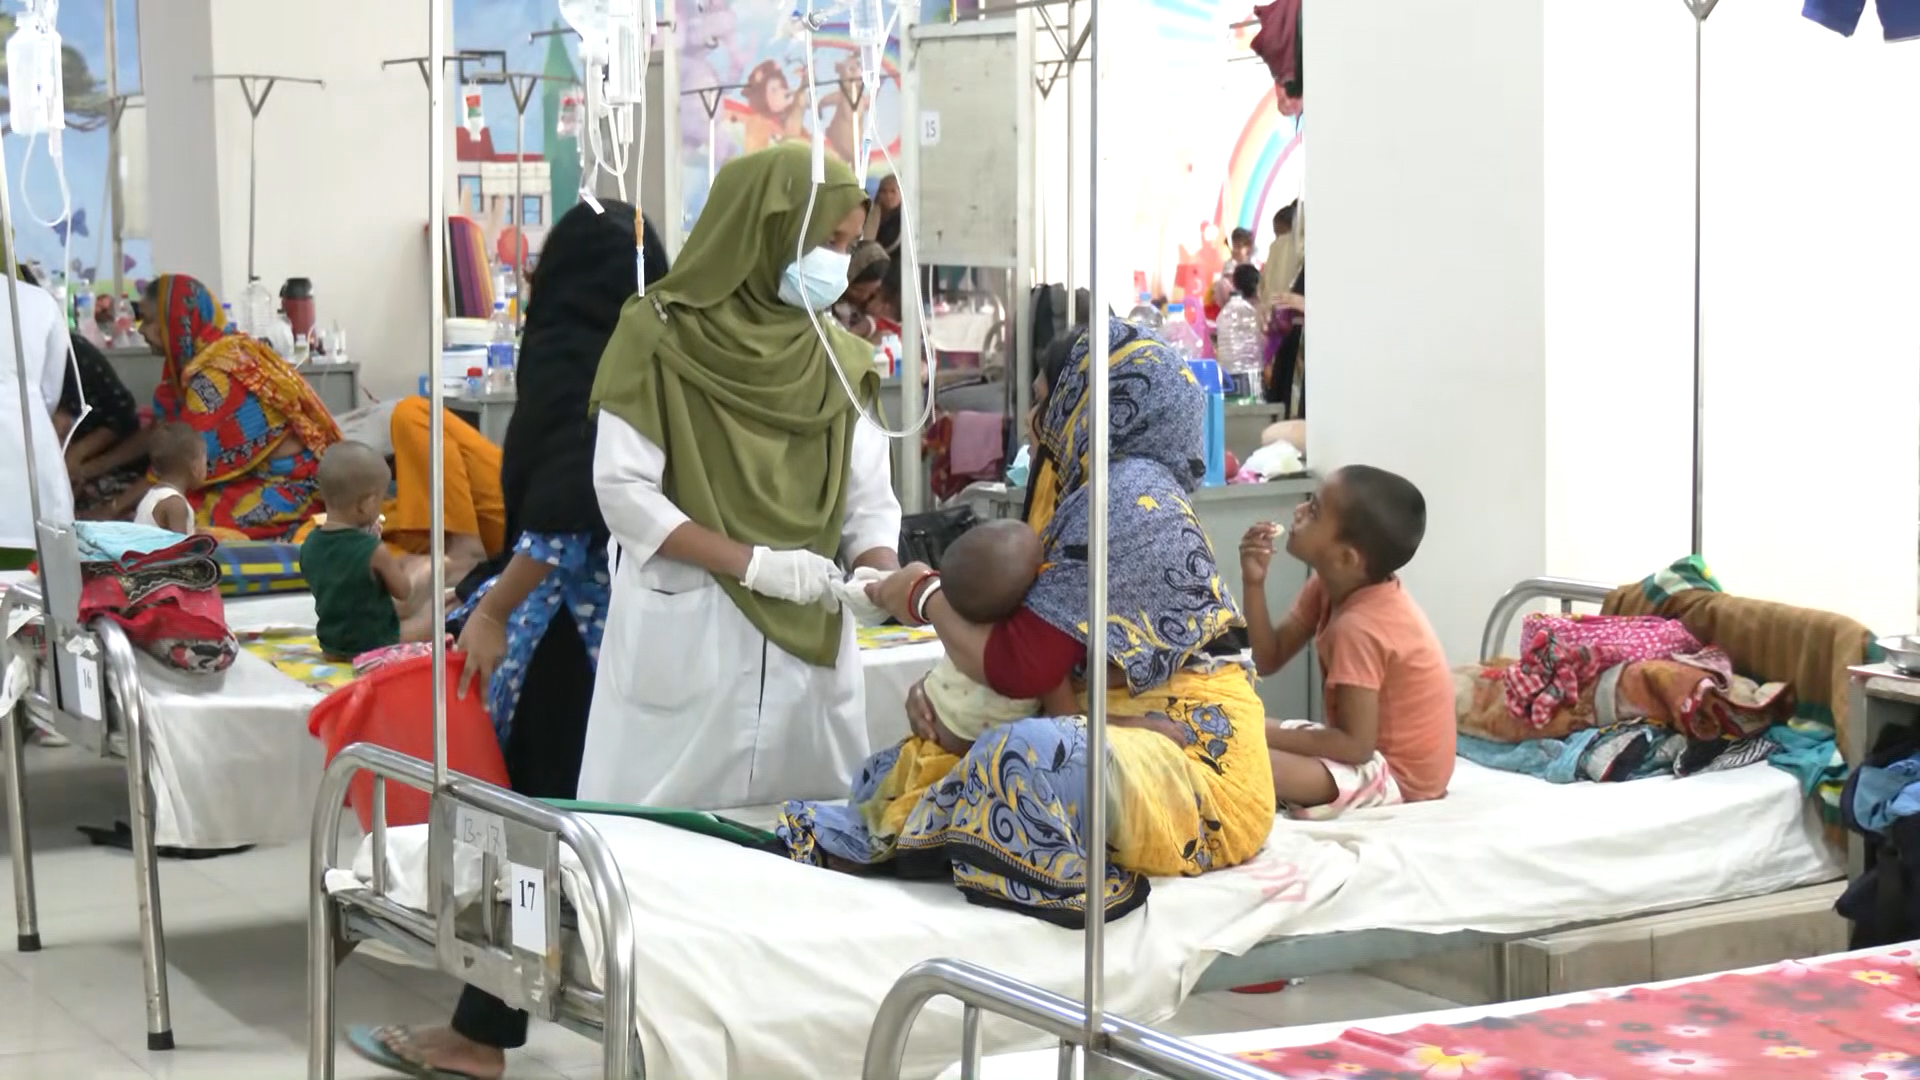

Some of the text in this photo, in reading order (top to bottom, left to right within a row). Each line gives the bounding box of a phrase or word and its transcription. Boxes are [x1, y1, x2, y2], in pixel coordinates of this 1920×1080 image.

[925, 120, 937, 138] 15
[82, 669, 93, 690] 16
[519, 879, 536, 911] 17
